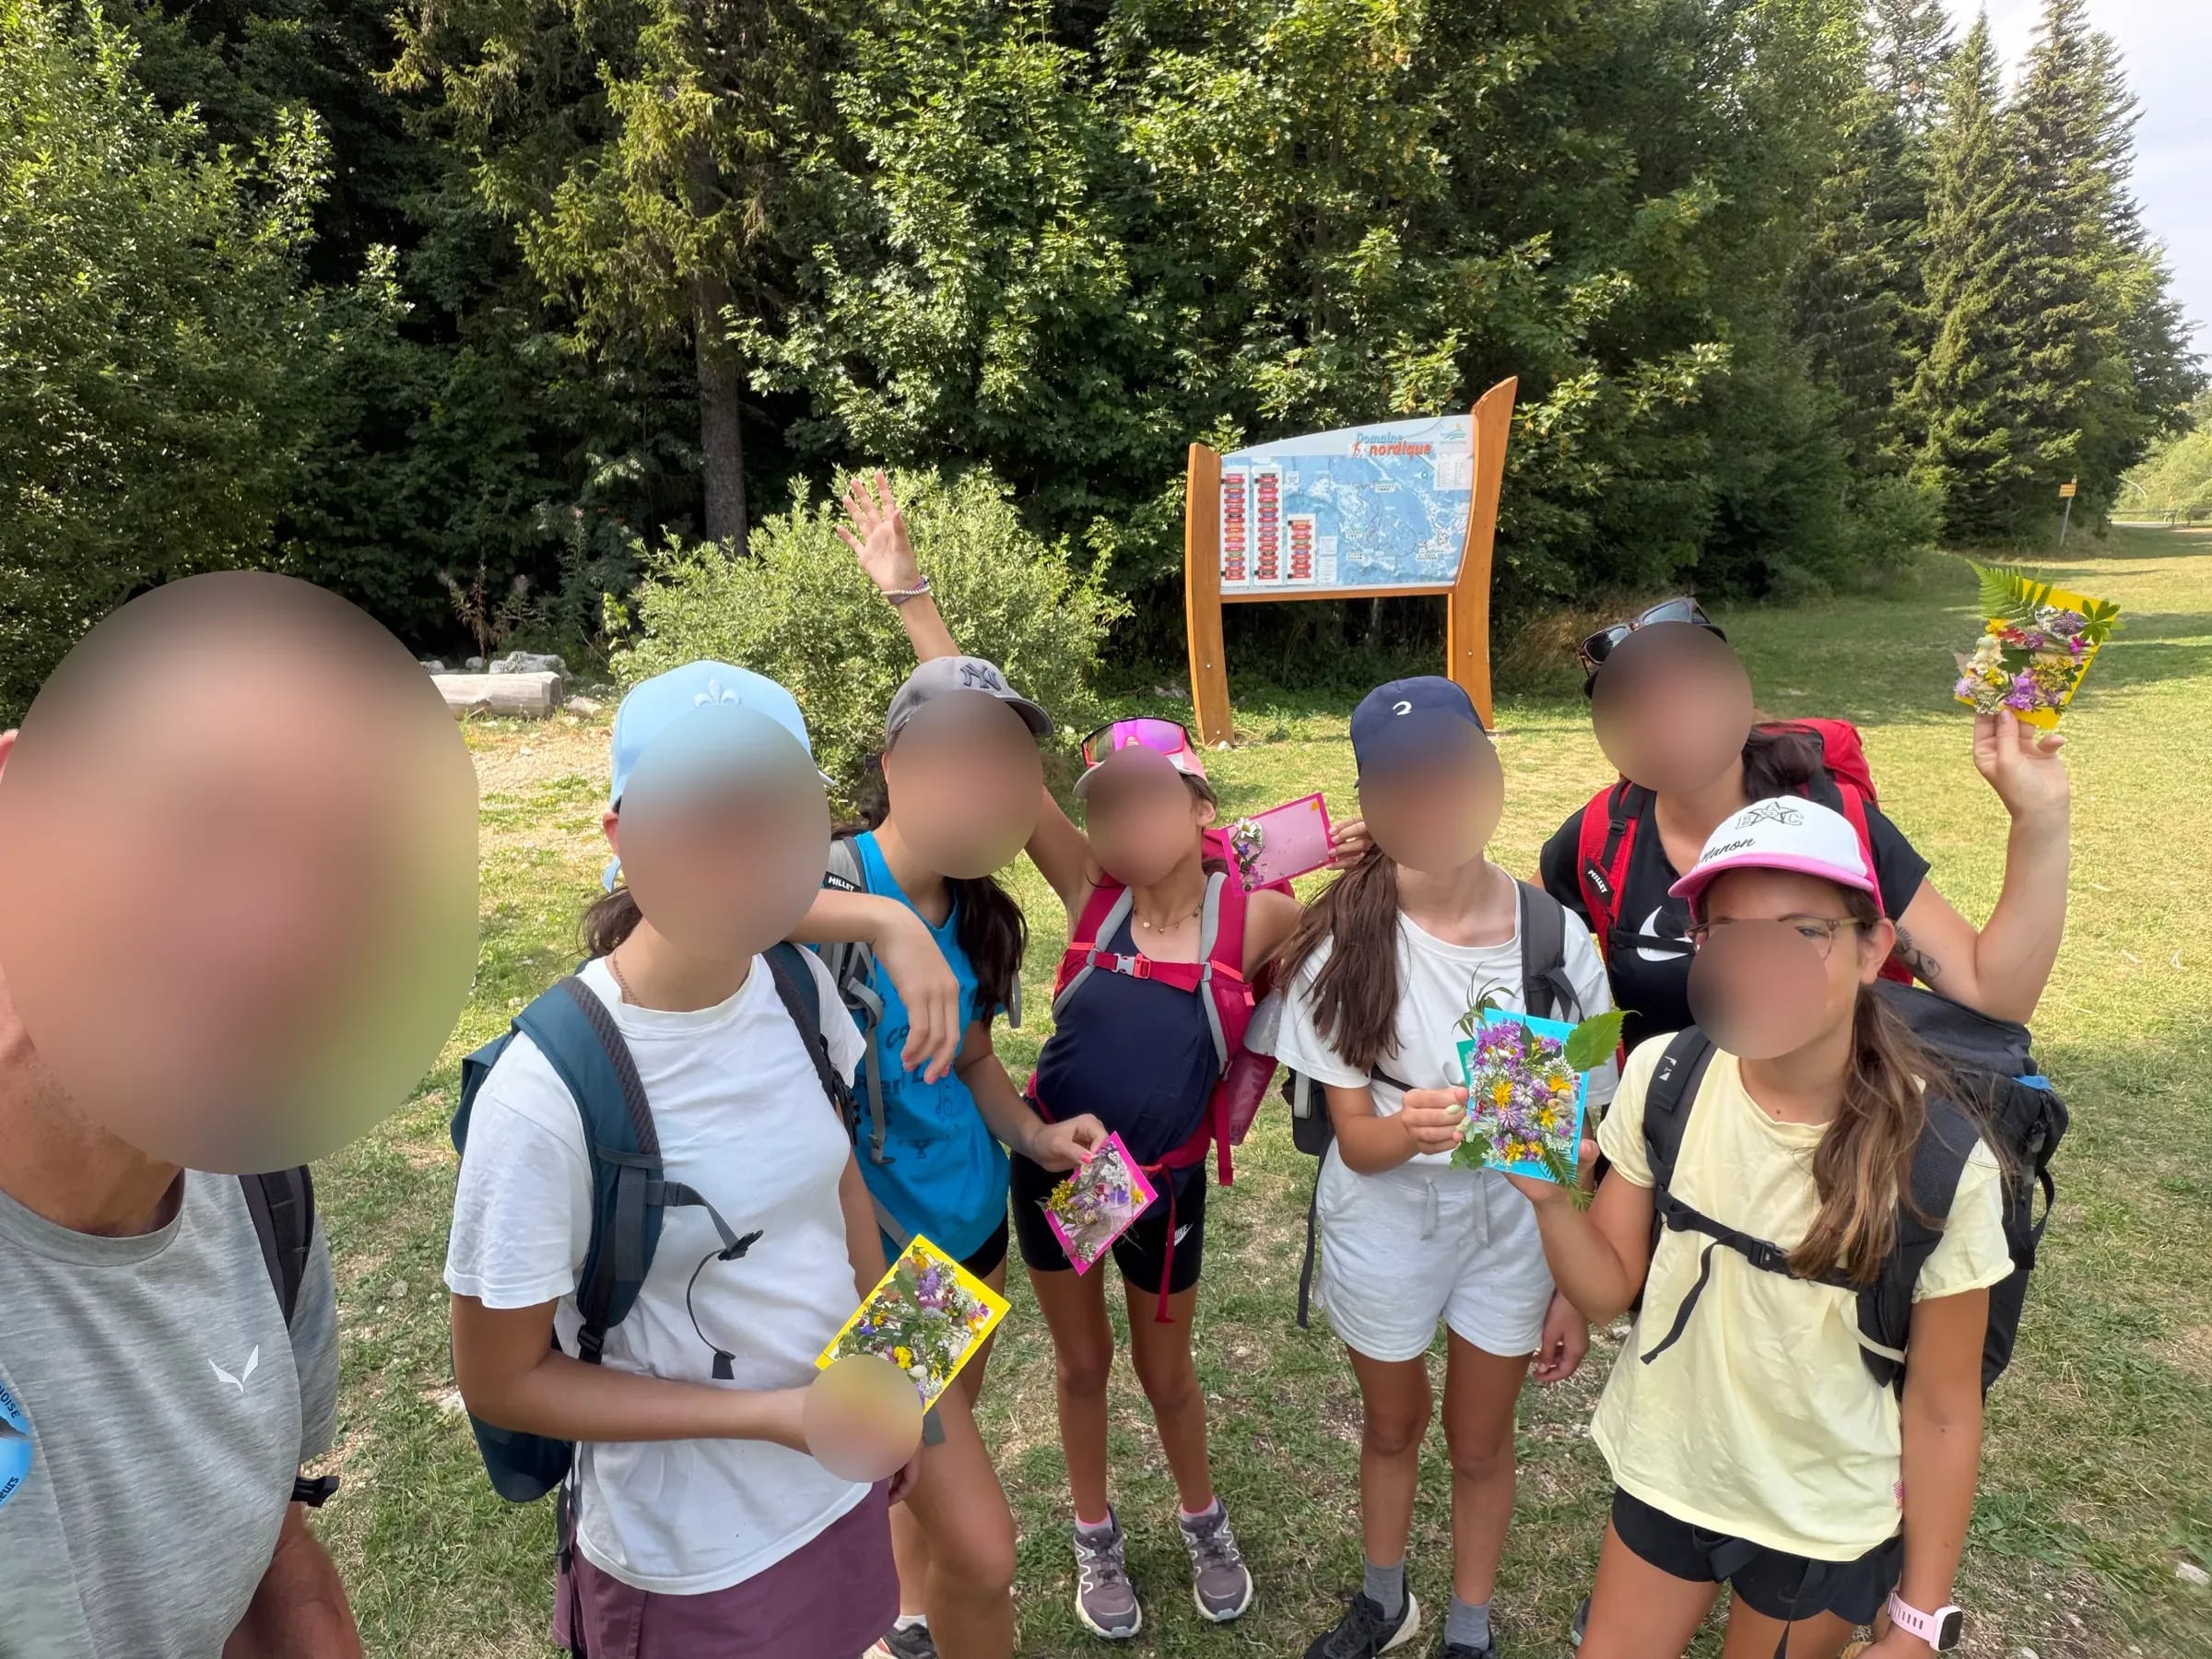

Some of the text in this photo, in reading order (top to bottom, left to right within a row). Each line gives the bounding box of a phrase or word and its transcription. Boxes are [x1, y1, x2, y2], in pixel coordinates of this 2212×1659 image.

[1357, 431, 1404, 443] Domaine
[1370, 440, 1431, 460] nordique
[960, 663, 1002, 691] NY
[1701, 838, 1756, 863] Manon
[828, 876, 854, 893] MILLET
[1587, 869, 1608, 893] MILLET
